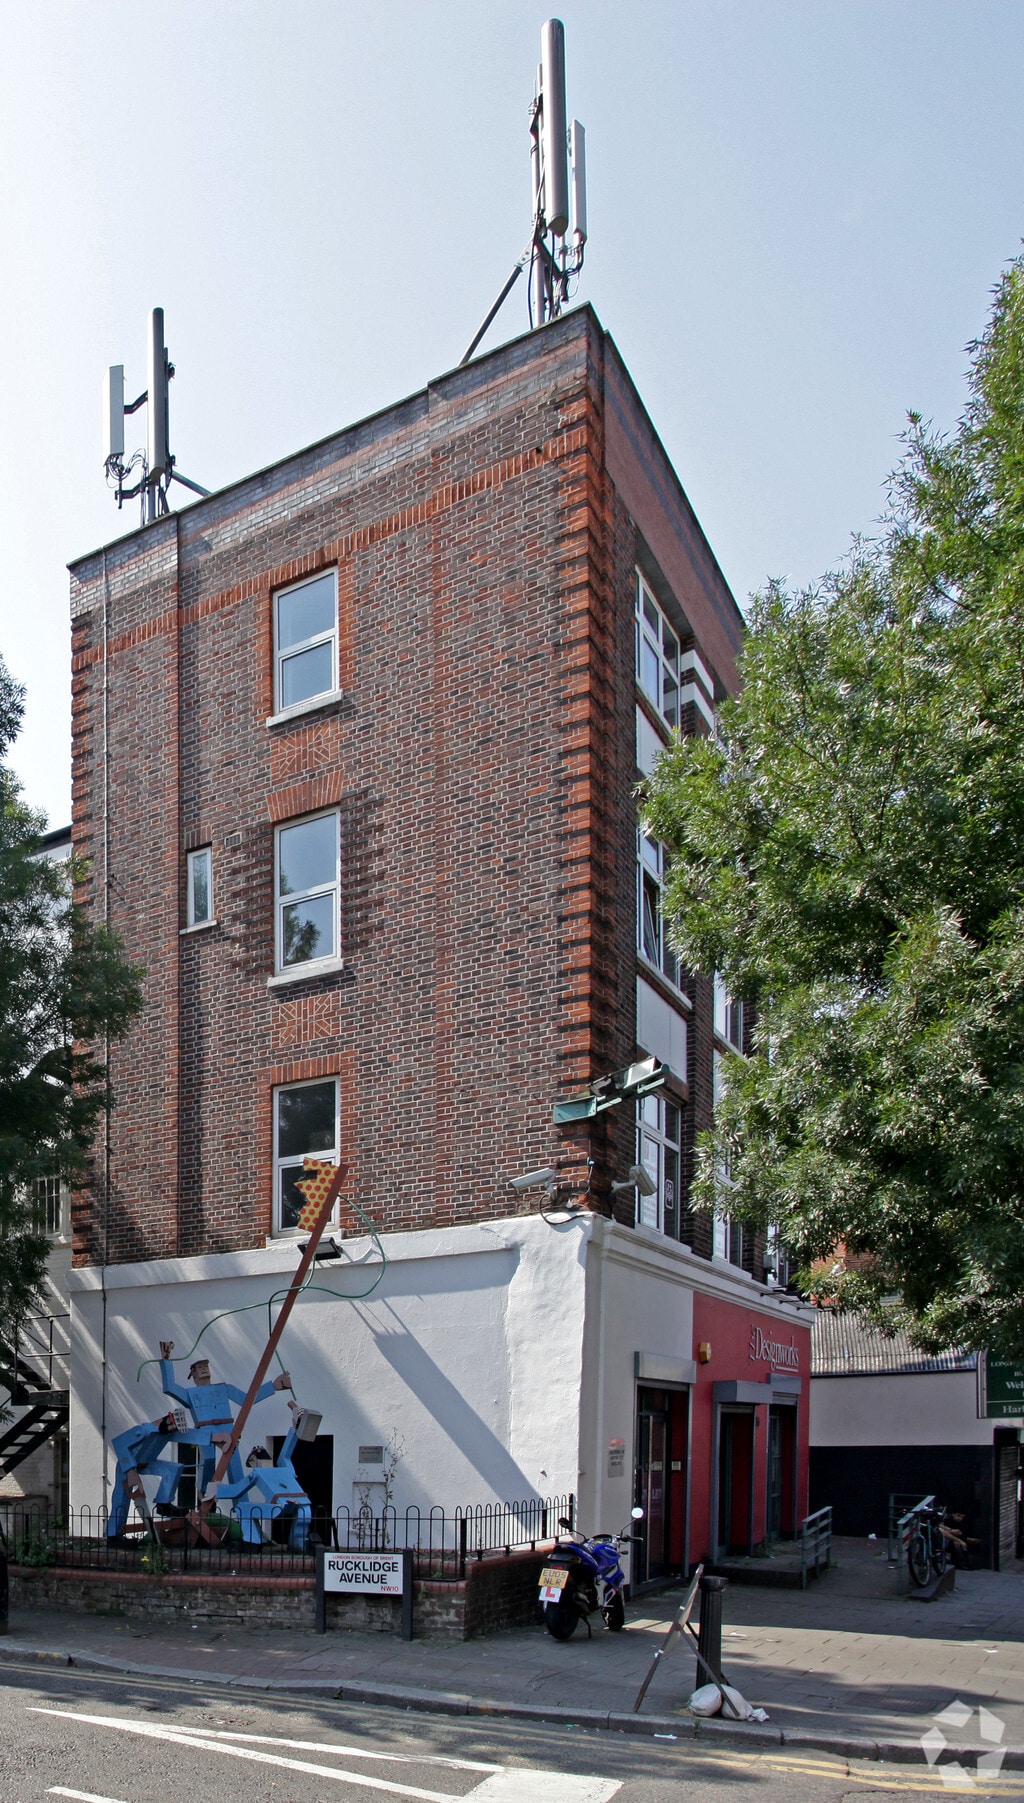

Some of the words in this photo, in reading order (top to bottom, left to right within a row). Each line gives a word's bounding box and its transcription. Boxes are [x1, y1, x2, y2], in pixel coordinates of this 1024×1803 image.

[756, 1327, 799, 1371] Designworks
[328, 1560, 399, 1573] RUCKLIDGE
[339, 1572, 388, 1585] AVENUE
[543, 1577, 562, 1586] NLR
[545, 1586, 555, 1598] L
